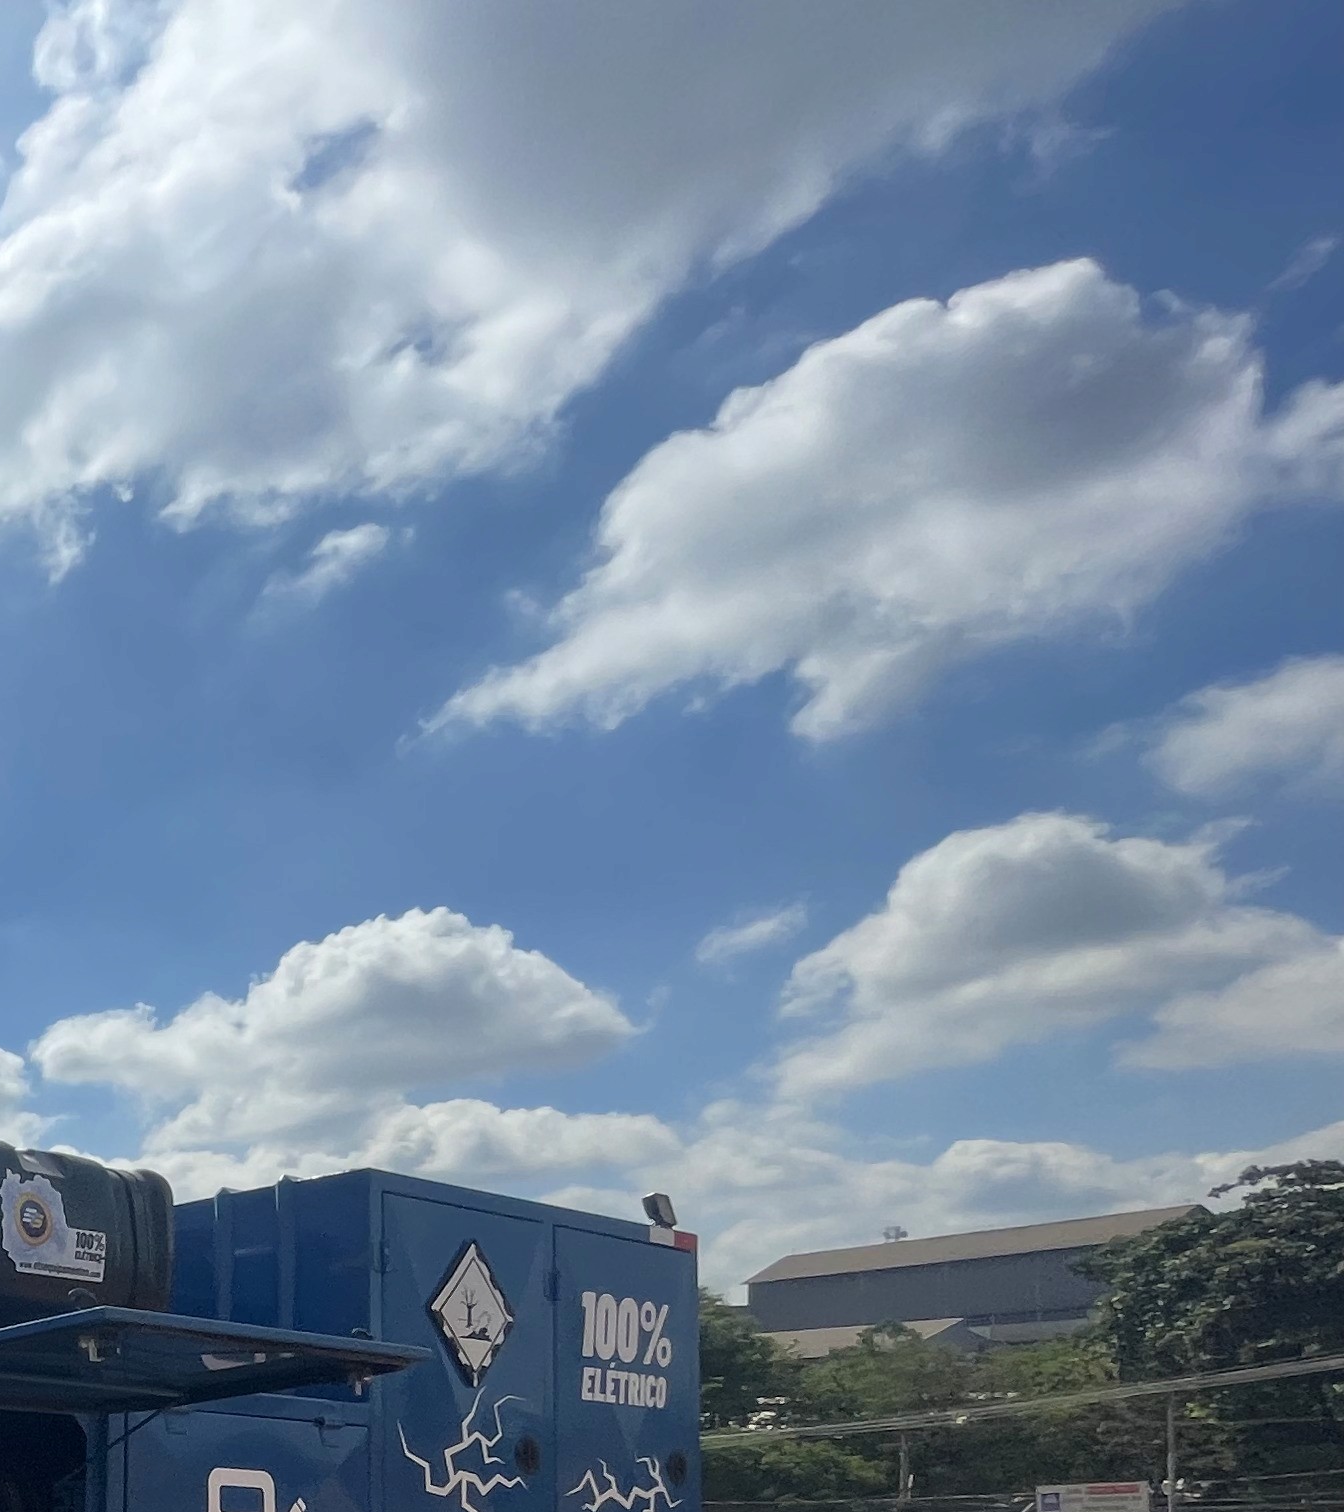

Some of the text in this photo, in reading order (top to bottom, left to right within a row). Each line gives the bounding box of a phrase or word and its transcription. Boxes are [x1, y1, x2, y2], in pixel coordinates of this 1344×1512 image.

[75, 1231, 105, 1252] 100%
[581, 1291, 672, 1368] 100%
[581, 1362, 668, 1409] ELÉTRICO
